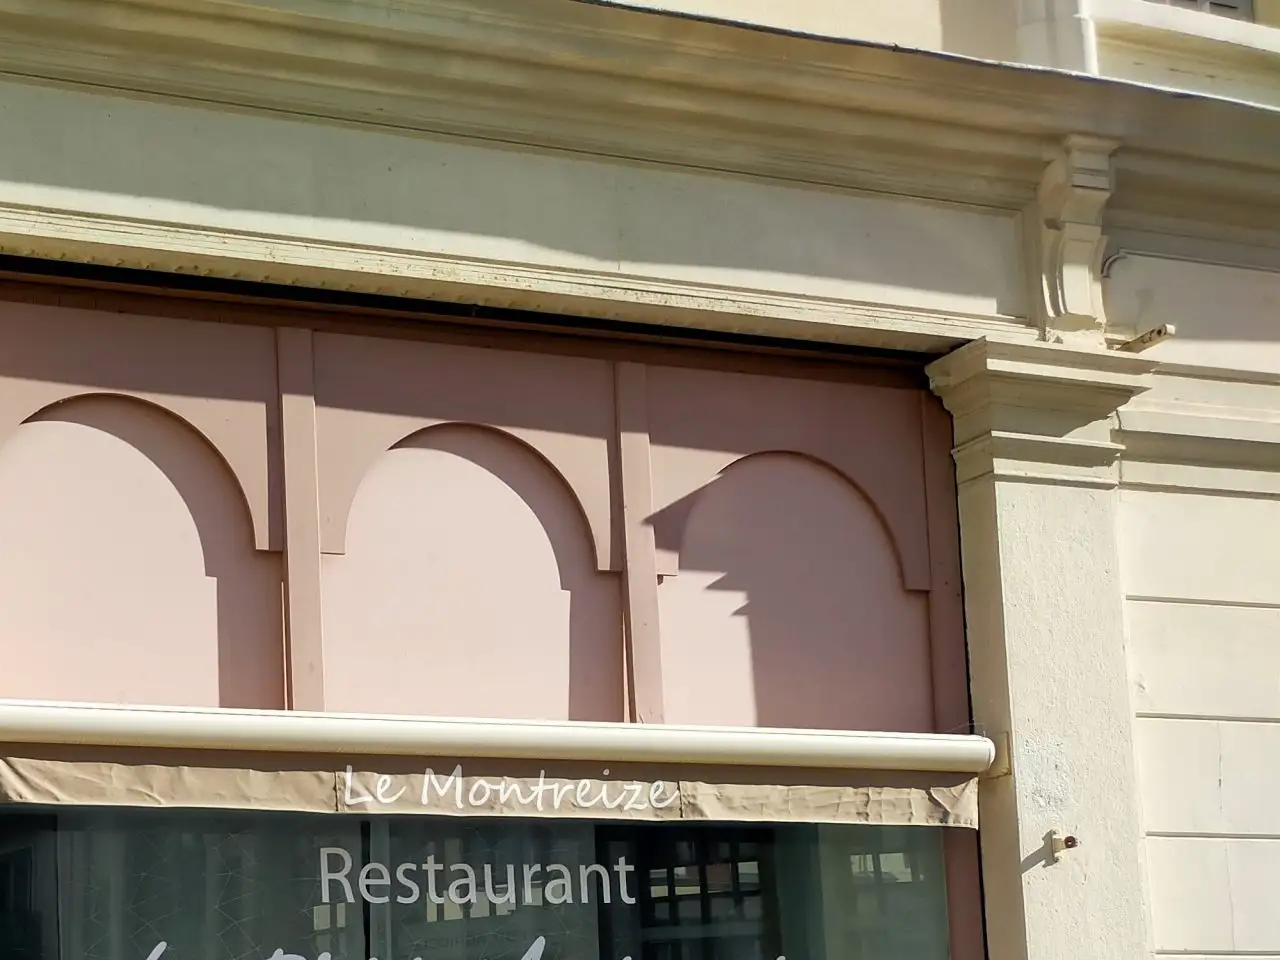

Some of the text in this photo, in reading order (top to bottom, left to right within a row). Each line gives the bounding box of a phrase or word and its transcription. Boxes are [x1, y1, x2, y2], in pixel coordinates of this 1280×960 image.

[343, 763, 681, 812] Le Montreize
[320, 845, 637, 905] Restaurant
